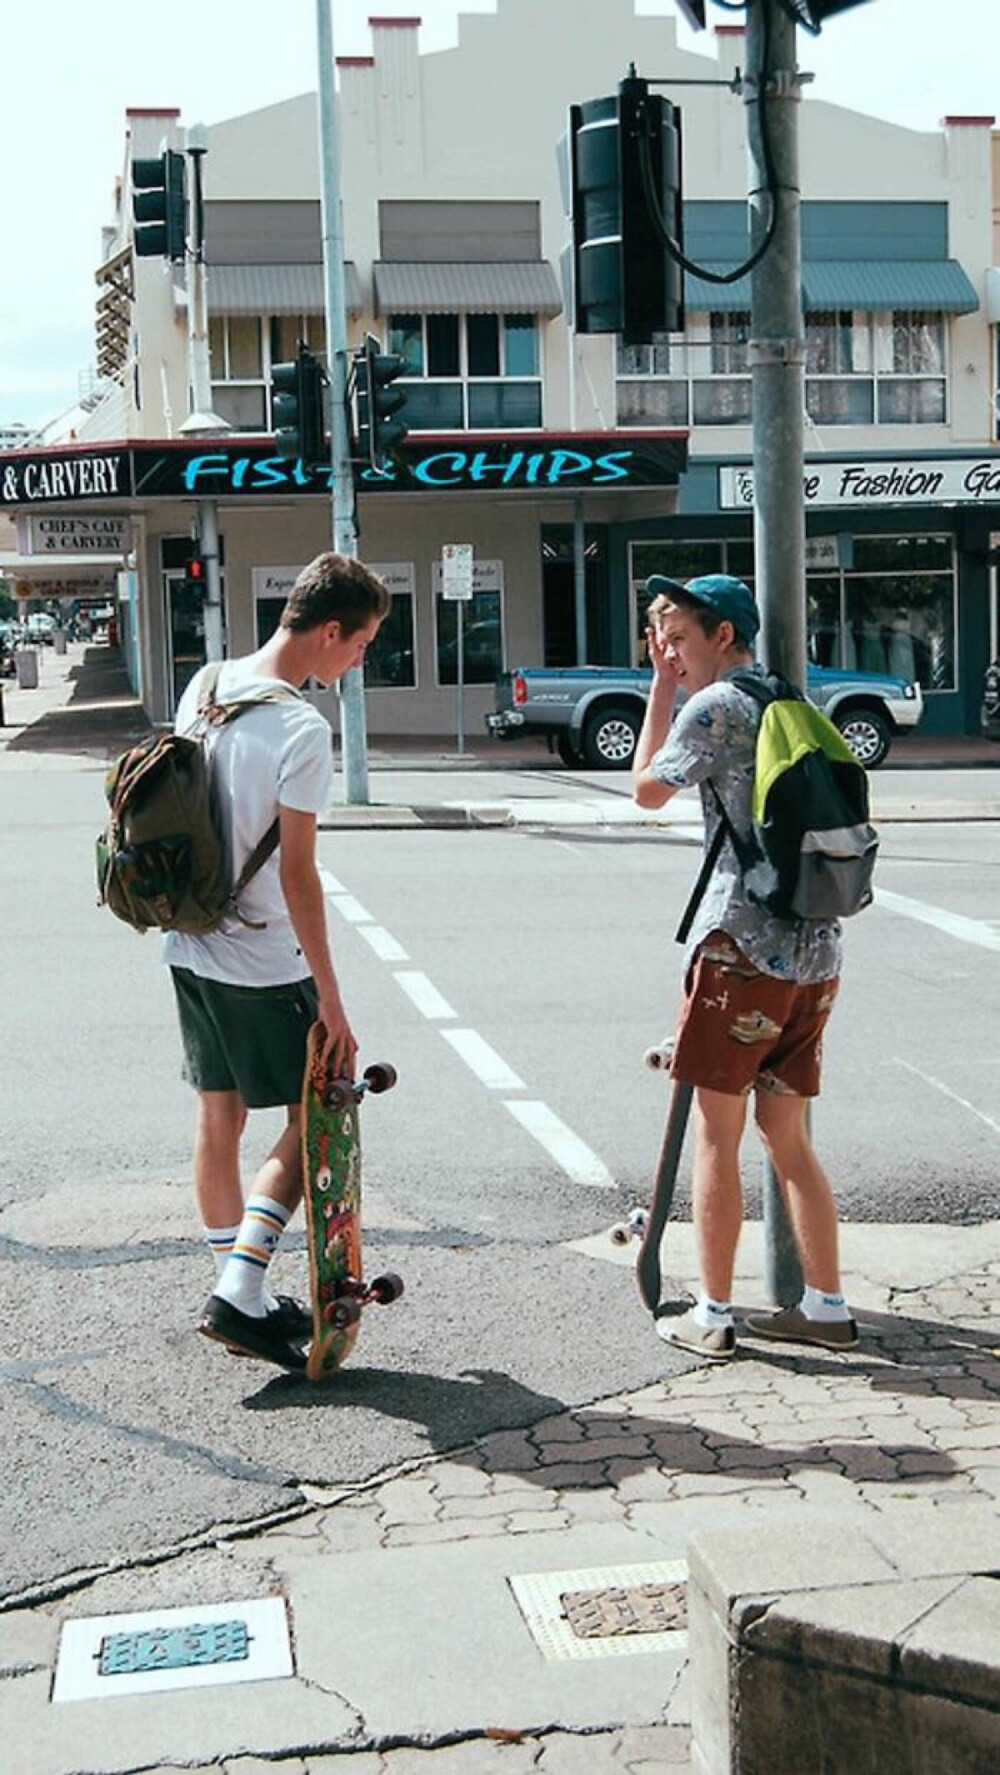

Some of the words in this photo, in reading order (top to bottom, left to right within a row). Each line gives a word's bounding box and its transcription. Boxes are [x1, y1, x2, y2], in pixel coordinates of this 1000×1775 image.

[3, 465, 19, 500] &
[24, 457, 120, 500] CARVERY
[414, 450, 633, 485] CHIPS
[839, 466, 944, 498] Fashion
[60, 535, 121, 549] CARVERY
